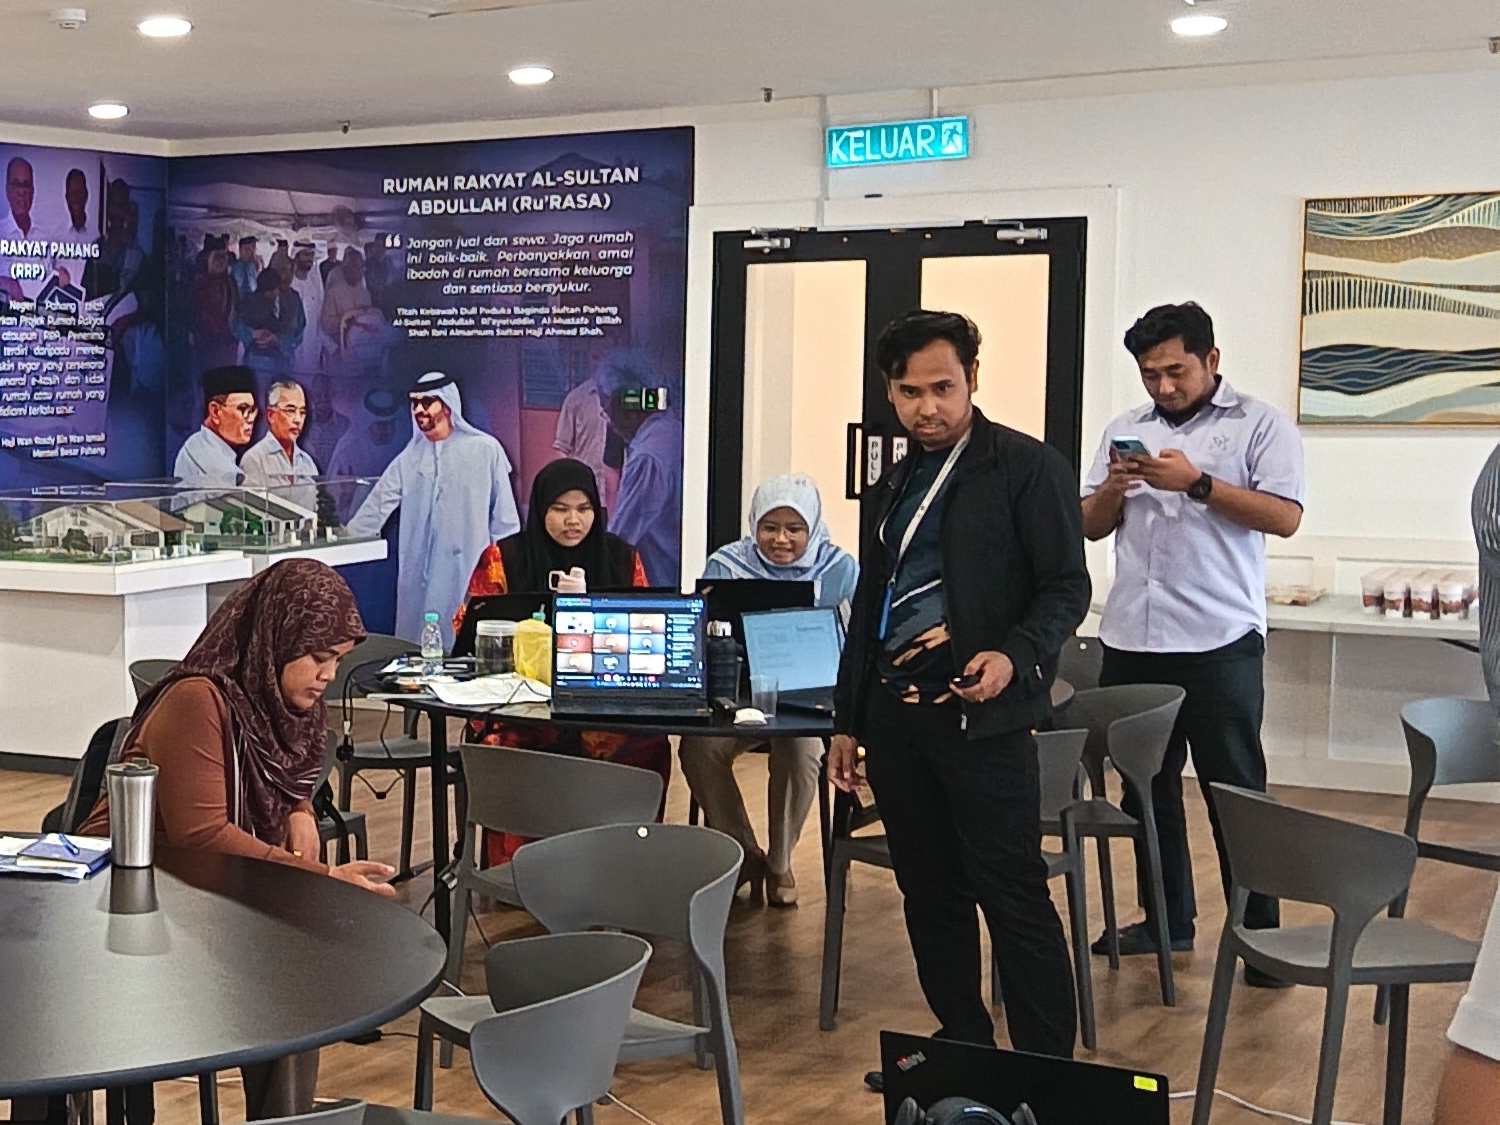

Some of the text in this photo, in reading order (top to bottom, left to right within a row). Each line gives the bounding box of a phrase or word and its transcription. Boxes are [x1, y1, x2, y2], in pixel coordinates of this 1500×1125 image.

[832, 125, 935, 163] KELUAR
[383, 167, 639, 193] RUMAH RAKYAT AL-SULTAN
[408, 193, 611, 216] ABDULLAH (Ru'RASA)
[1, 240, 49, 256] RAKYAT
[51, 243, 99, 258] PAHANG
[406, 232, 634, 250] Jangan jual dan sewa. Jaga rumah
[407, 247, 634, 264] ini baik-baik. Perbanyakkan amal
[11, 263, 45, 279] (RRP)
[407, 264, 632, 280] ibadah di rumah bersama keluarga
[443, 282, 592, 295] dan sentiasa bersyukur.
